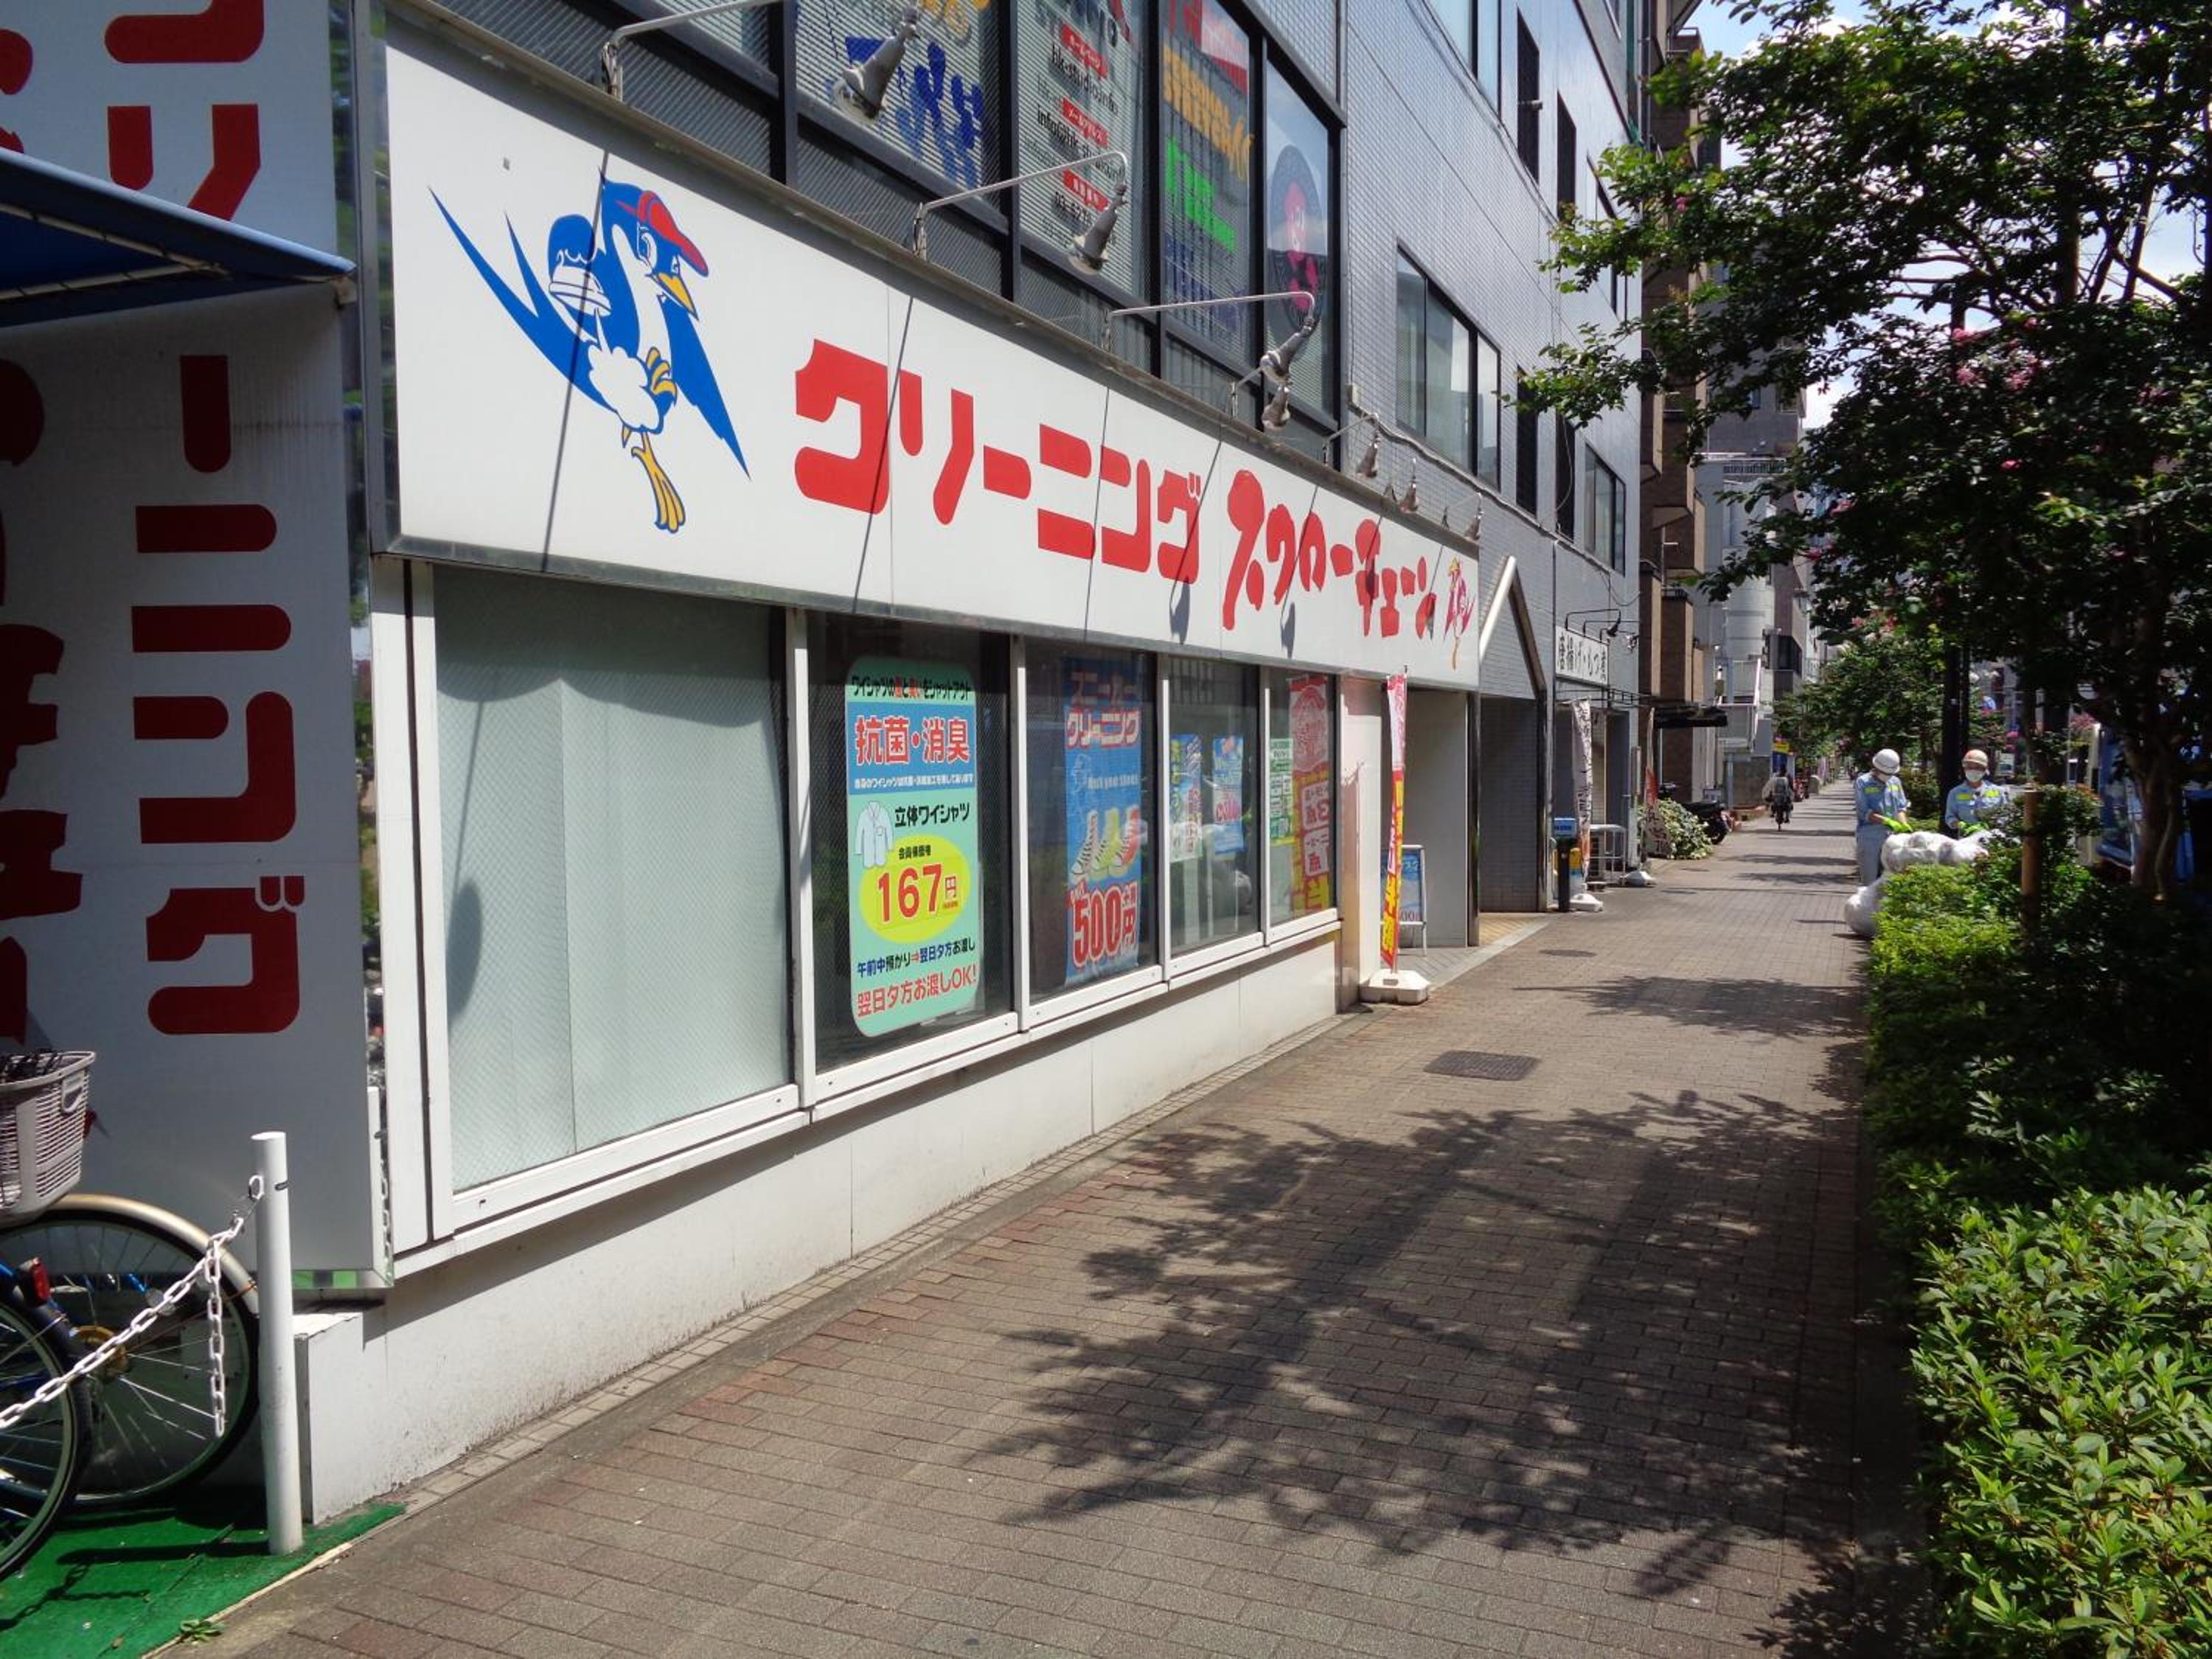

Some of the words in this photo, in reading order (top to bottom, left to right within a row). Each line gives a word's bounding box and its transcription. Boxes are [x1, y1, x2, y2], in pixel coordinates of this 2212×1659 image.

[795, 338, 1200, 585] クリーニング
[855, 714, 970, 766] 抗菌・消臭
[894, 803, 970, 827] 立体ワイシャツ
[877, 863, 956, 923] 167円
[857, 965, 978, 1018] 翌日夕方お渡しOK!
